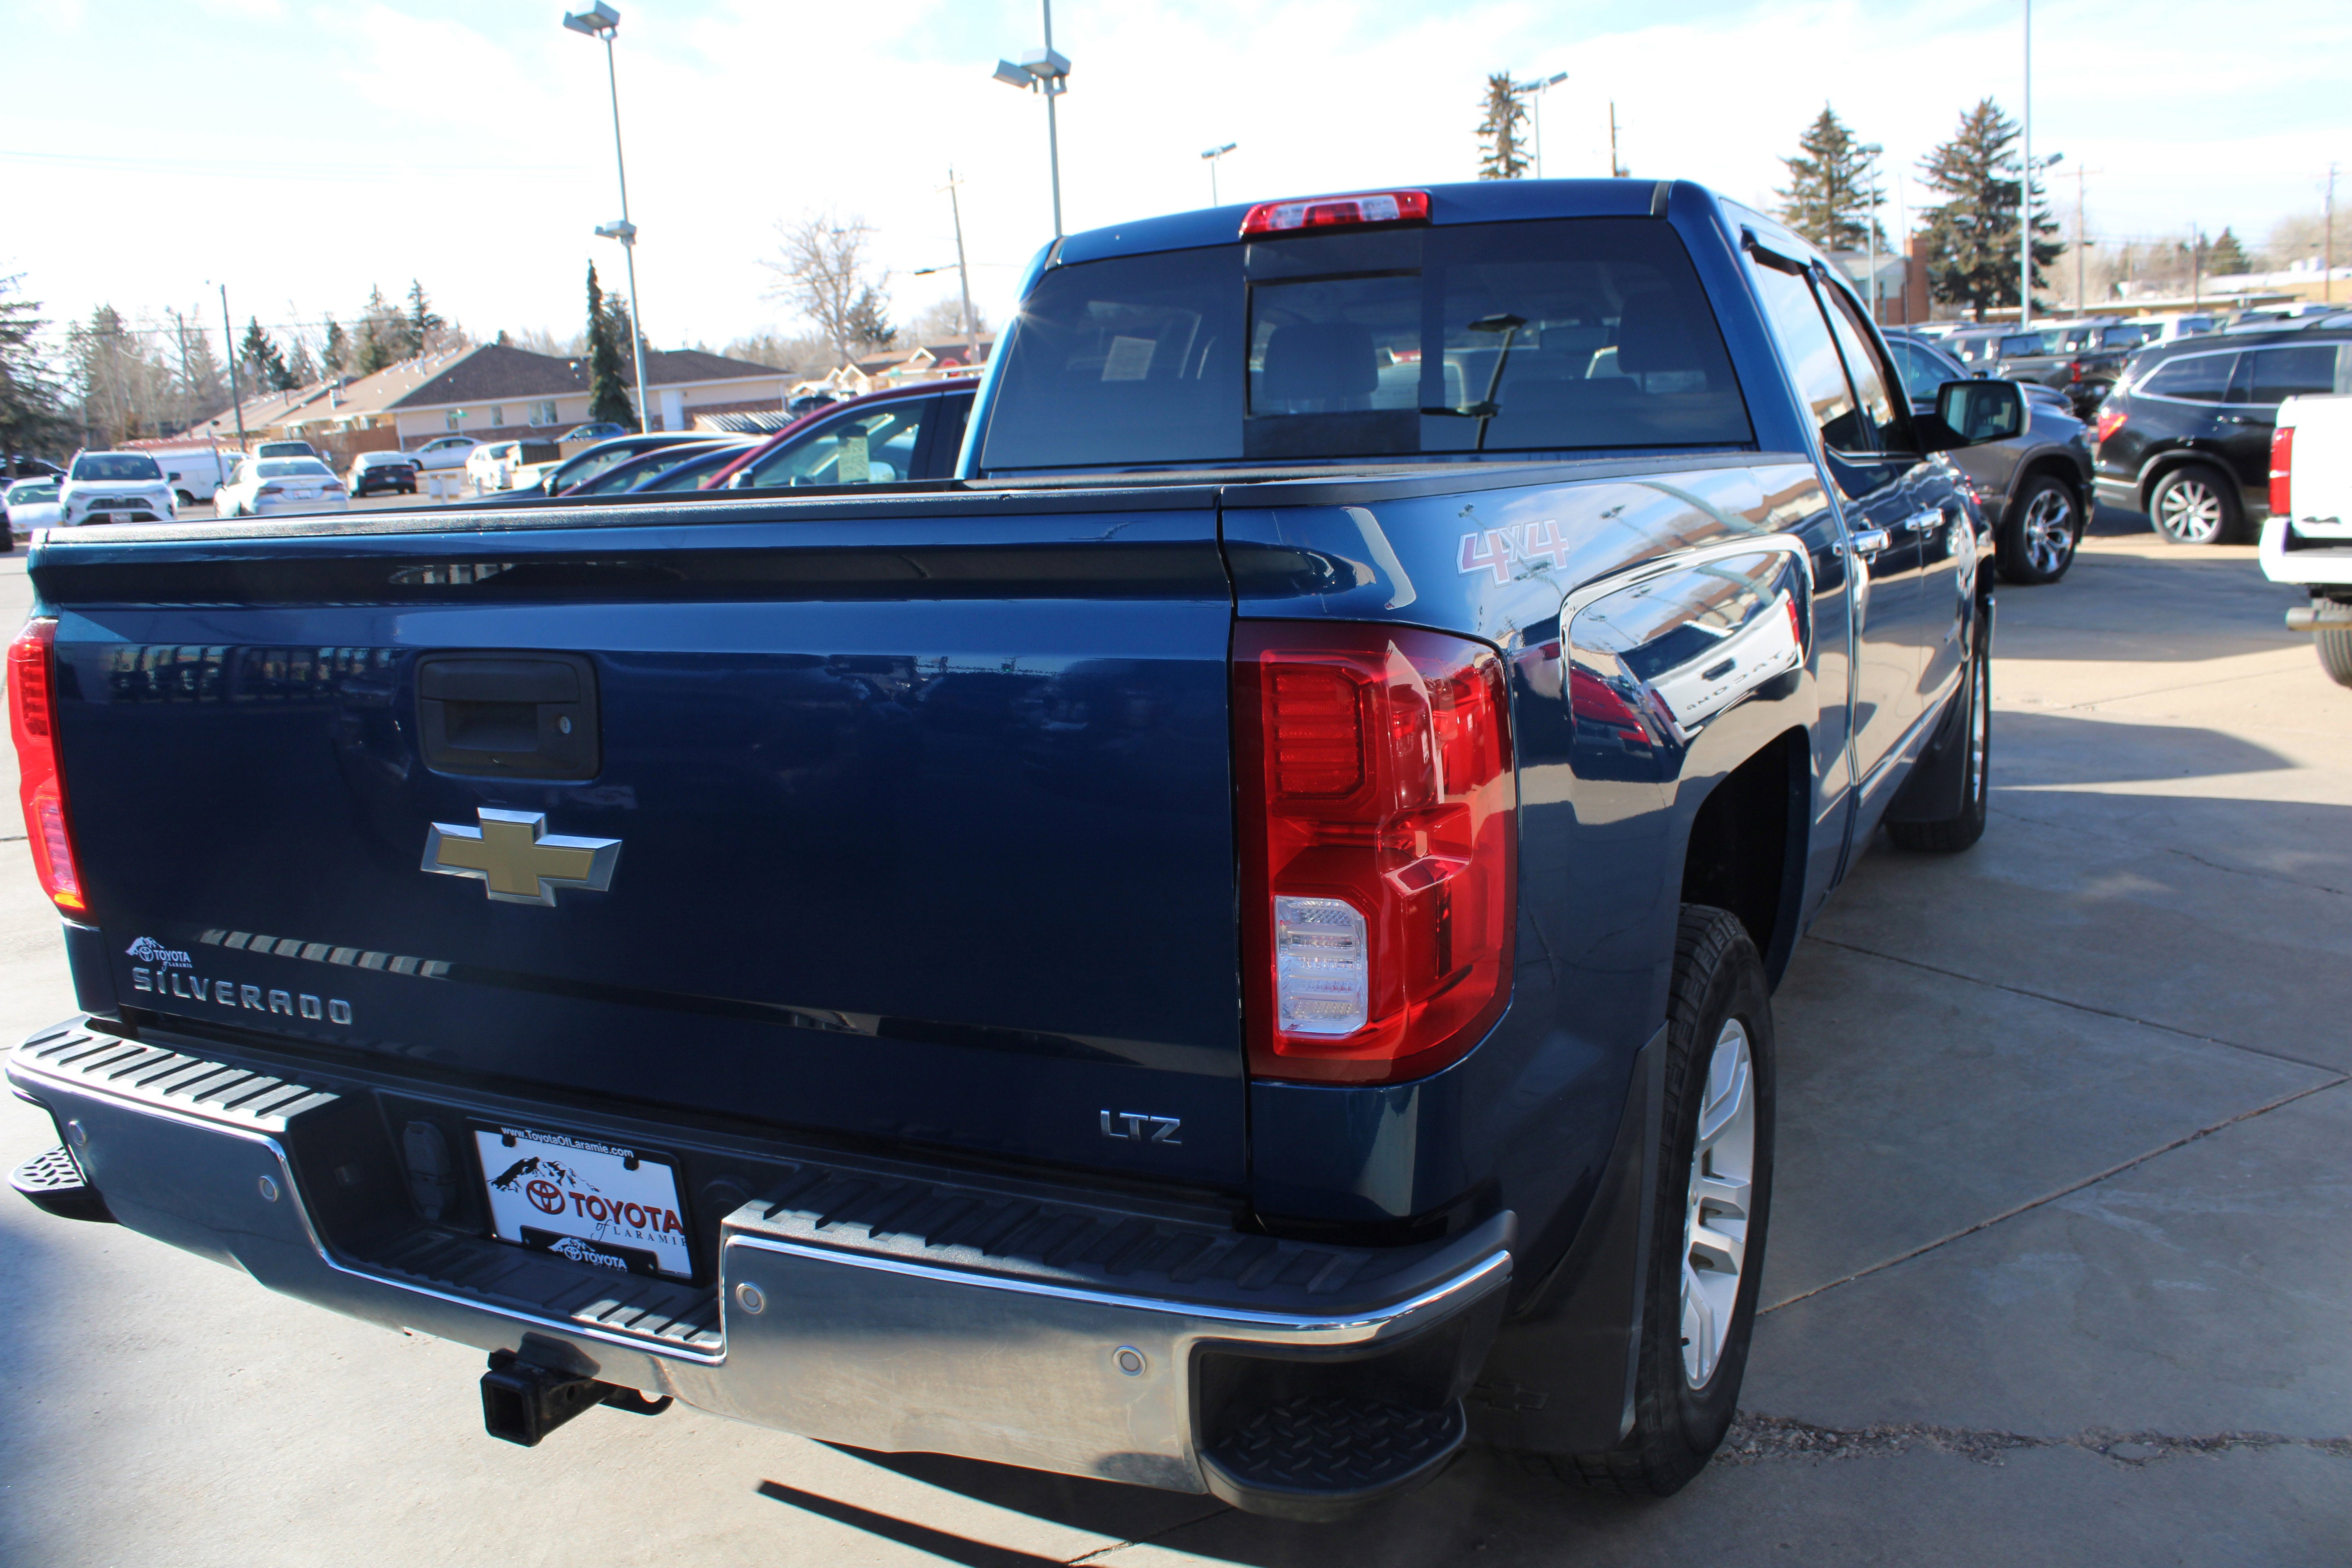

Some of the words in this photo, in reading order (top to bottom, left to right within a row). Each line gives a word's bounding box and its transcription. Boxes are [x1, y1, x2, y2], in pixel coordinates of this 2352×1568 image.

[153, 949, 191, 962] TOYOTA
[132, 967, 352, 1025] SILVERADO
[501, 1127, 634, 1157] www.ToyotaOfLaramie.com
[1100, 1110, 1182, 1145] LTZ
[568, 1191, 684, 1235] TOYOTA
[582, 1251, 628, 1269] TOYOTA
